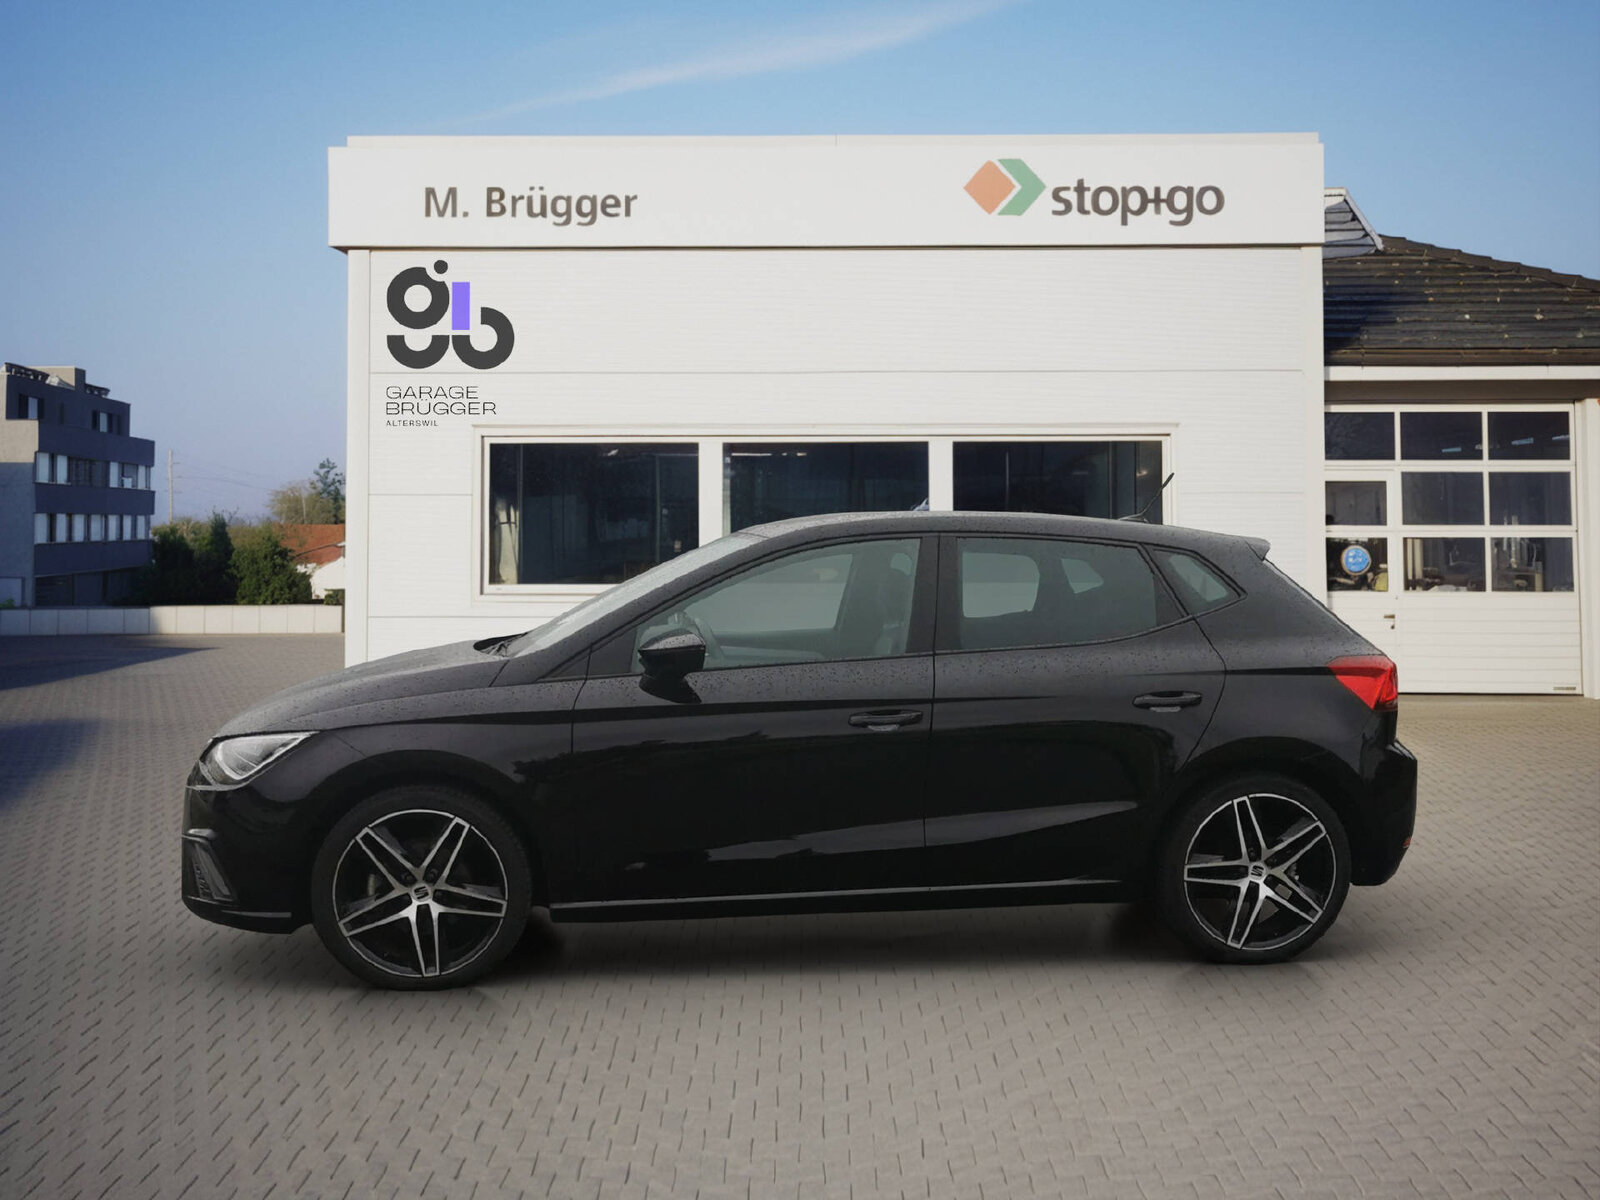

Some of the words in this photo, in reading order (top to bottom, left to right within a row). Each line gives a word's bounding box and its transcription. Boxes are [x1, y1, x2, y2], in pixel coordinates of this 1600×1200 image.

[424, 186, 469, 218] M.
[485, 185, 639, 227] Brügger
[1051, 178, 1226, 227] stop+go
